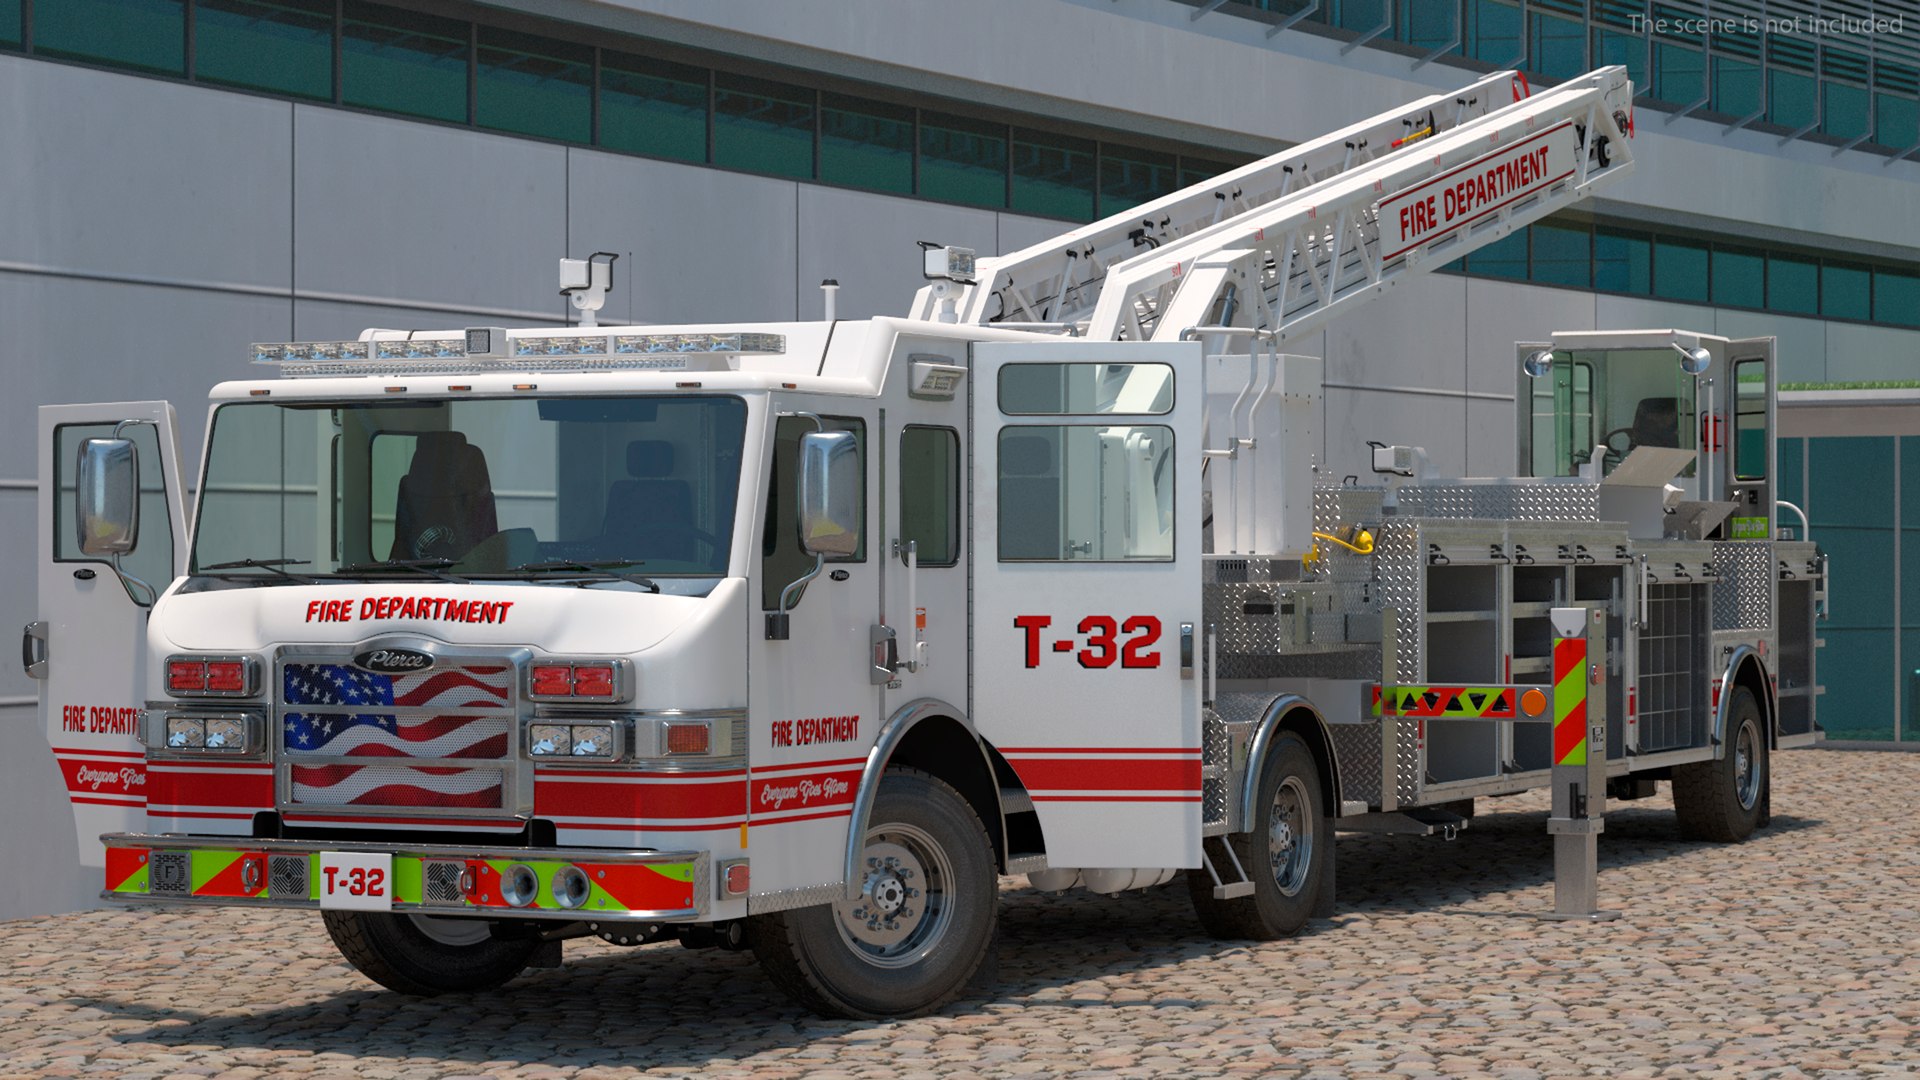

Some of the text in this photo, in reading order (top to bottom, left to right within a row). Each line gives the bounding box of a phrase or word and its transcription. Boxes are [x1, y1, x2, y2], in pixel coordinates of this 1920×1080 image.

[1400, 145, 1549, 242] FIRE DEPARTMENT
[305, 596, 514, 624] FIRE DEPARTMENT
[1014, 615, 1162, 669] T-32
[365, 650, 424, 669] Pierce
[63, 704, 86, 733] FIRE
[771, 715, 860, 748] FIRE DEPARTMENT
[77, 765, 146, 791] Everyone Goes
[761, 777, 849, 810] Everyone Goes Home
[323, 866, 385, 897] T-32
